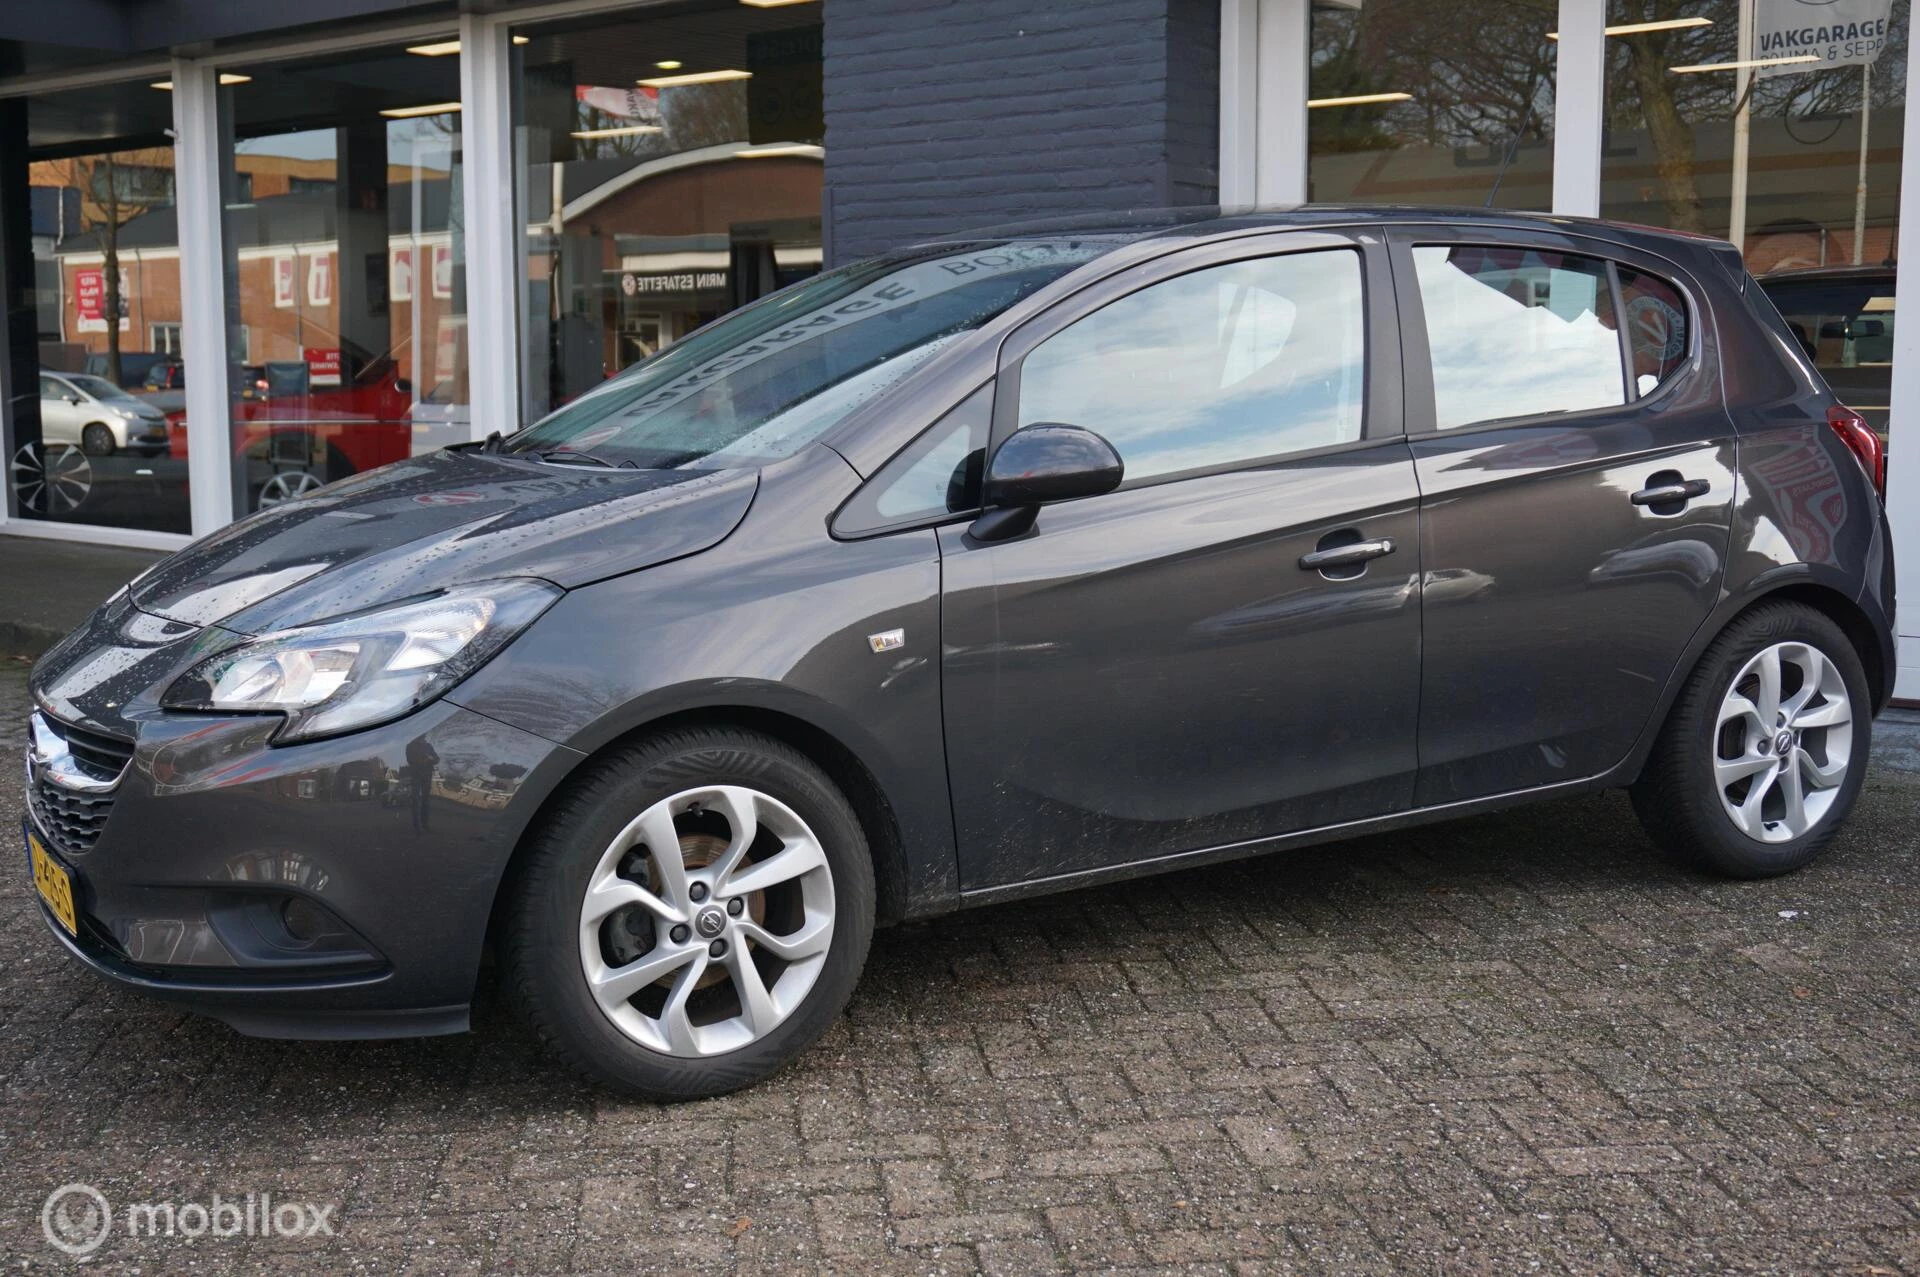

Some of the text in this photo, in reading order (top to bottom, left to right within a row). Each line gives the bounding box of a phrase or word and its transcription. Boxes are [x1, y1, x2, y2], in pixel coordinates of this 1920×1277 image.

[1760, 18, 1885, 51] VAKGARAGE
[1827, 45, 1838, 60] &
[1843, 38, 1884, 59] SEPP
